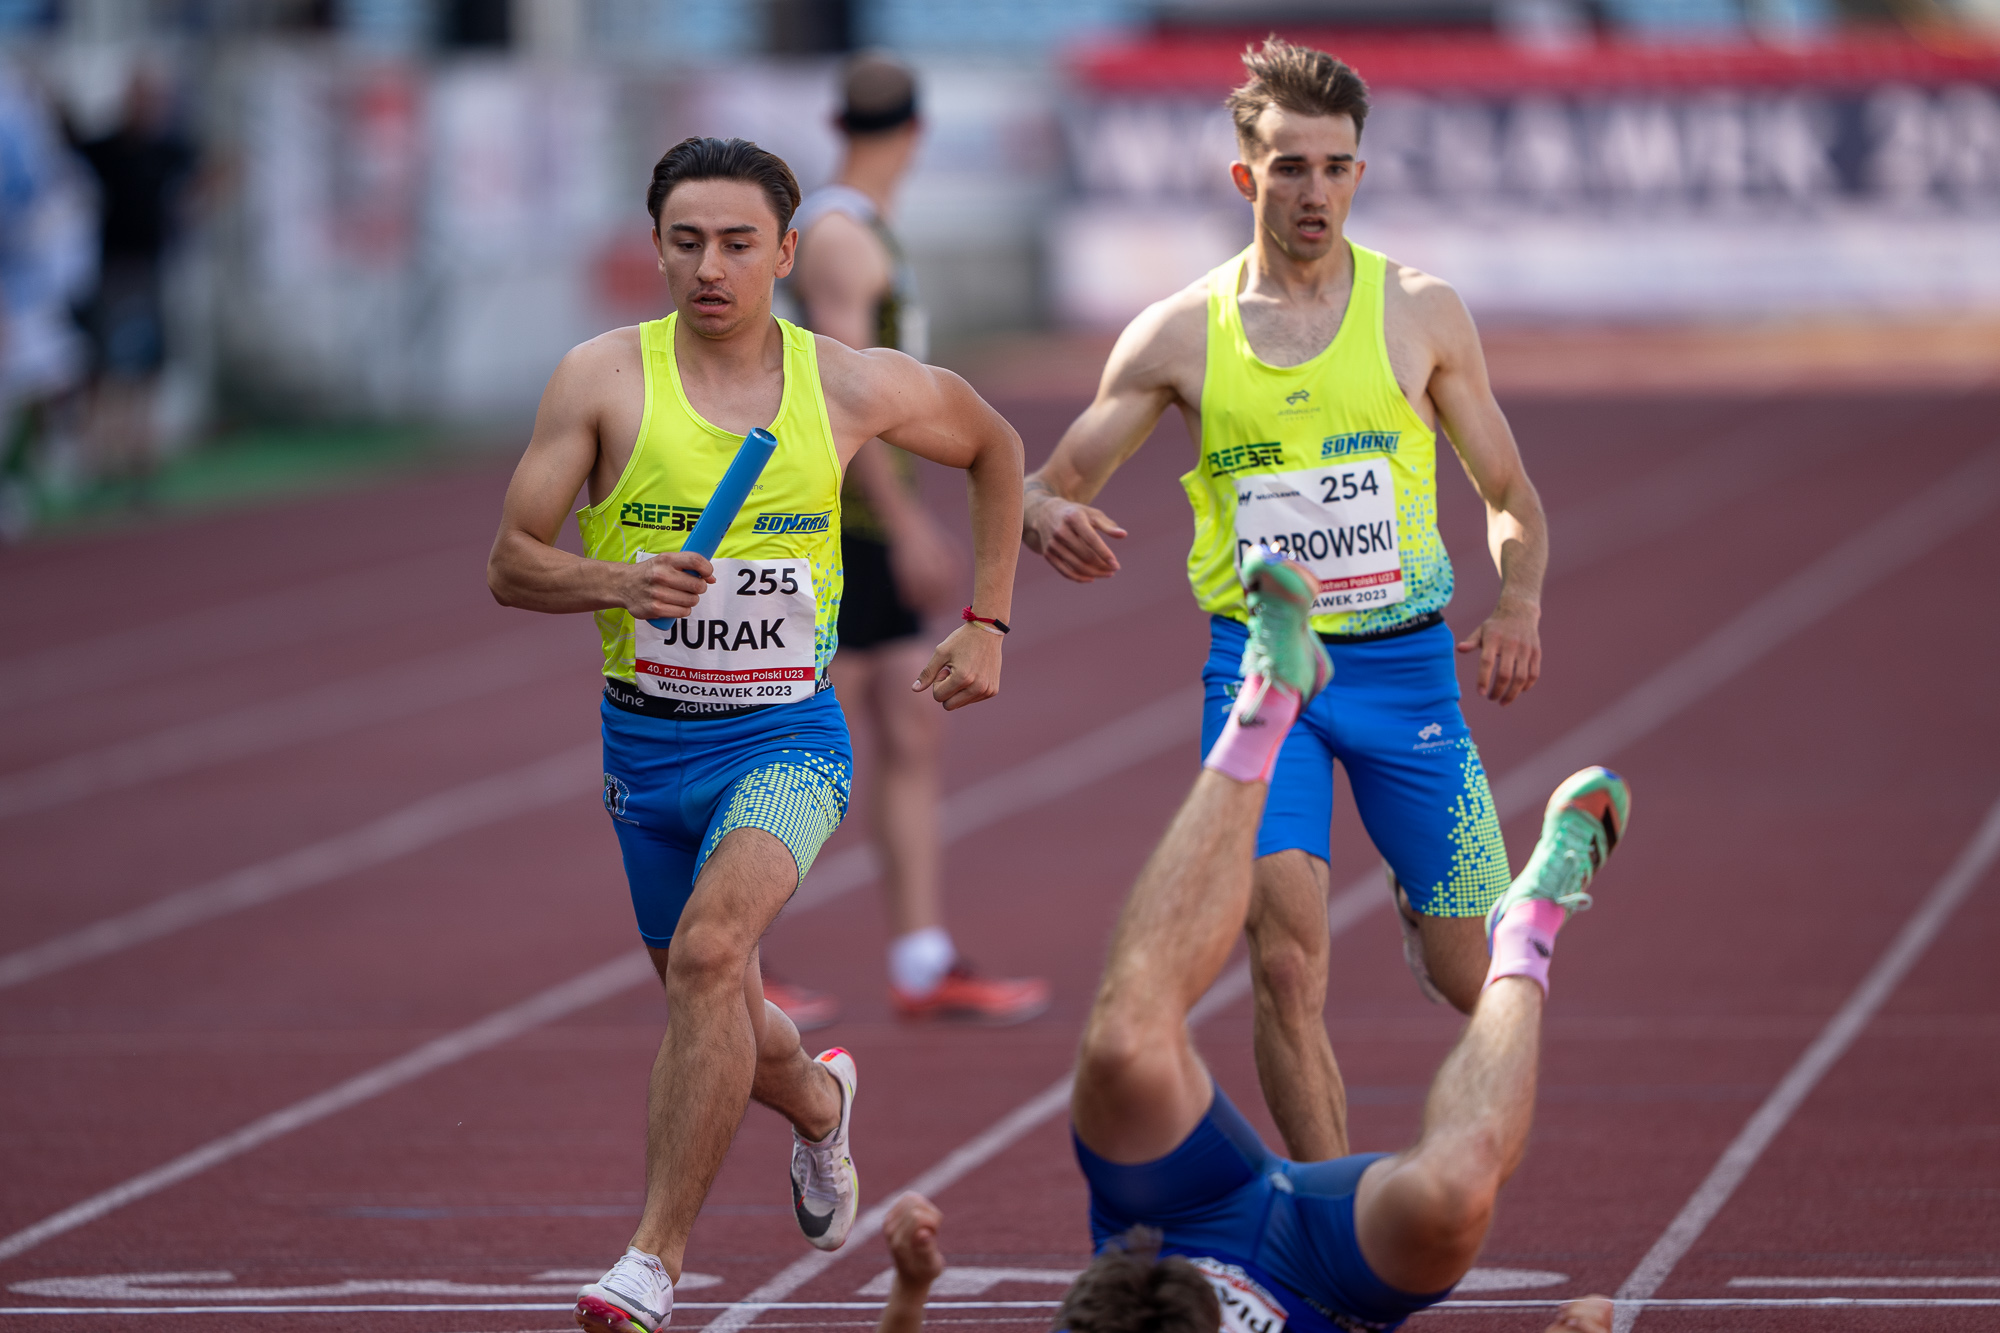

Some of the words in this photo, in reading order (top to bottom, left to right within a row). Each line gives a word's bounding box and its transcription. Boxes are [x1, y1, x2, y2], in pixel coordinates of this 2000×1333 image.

[1319, 469, 1379, 504] 254
[736, 567, 799, 596] 255
[1355, 588, 1387, 603] 2023
[663, 617, 786, 651] JURAK
[647, 664, 662, 674] 40.
[664, 667, 687, 678] PZLA
[689, 671, 750, 682] Mistrzostwa
[752, 670, 781, 680] Polski
[784, 670, 804, 679] U23
[657, 680, 753, 698] WŁOCŁAWEK
[756, 685, 792, 697] 2023
